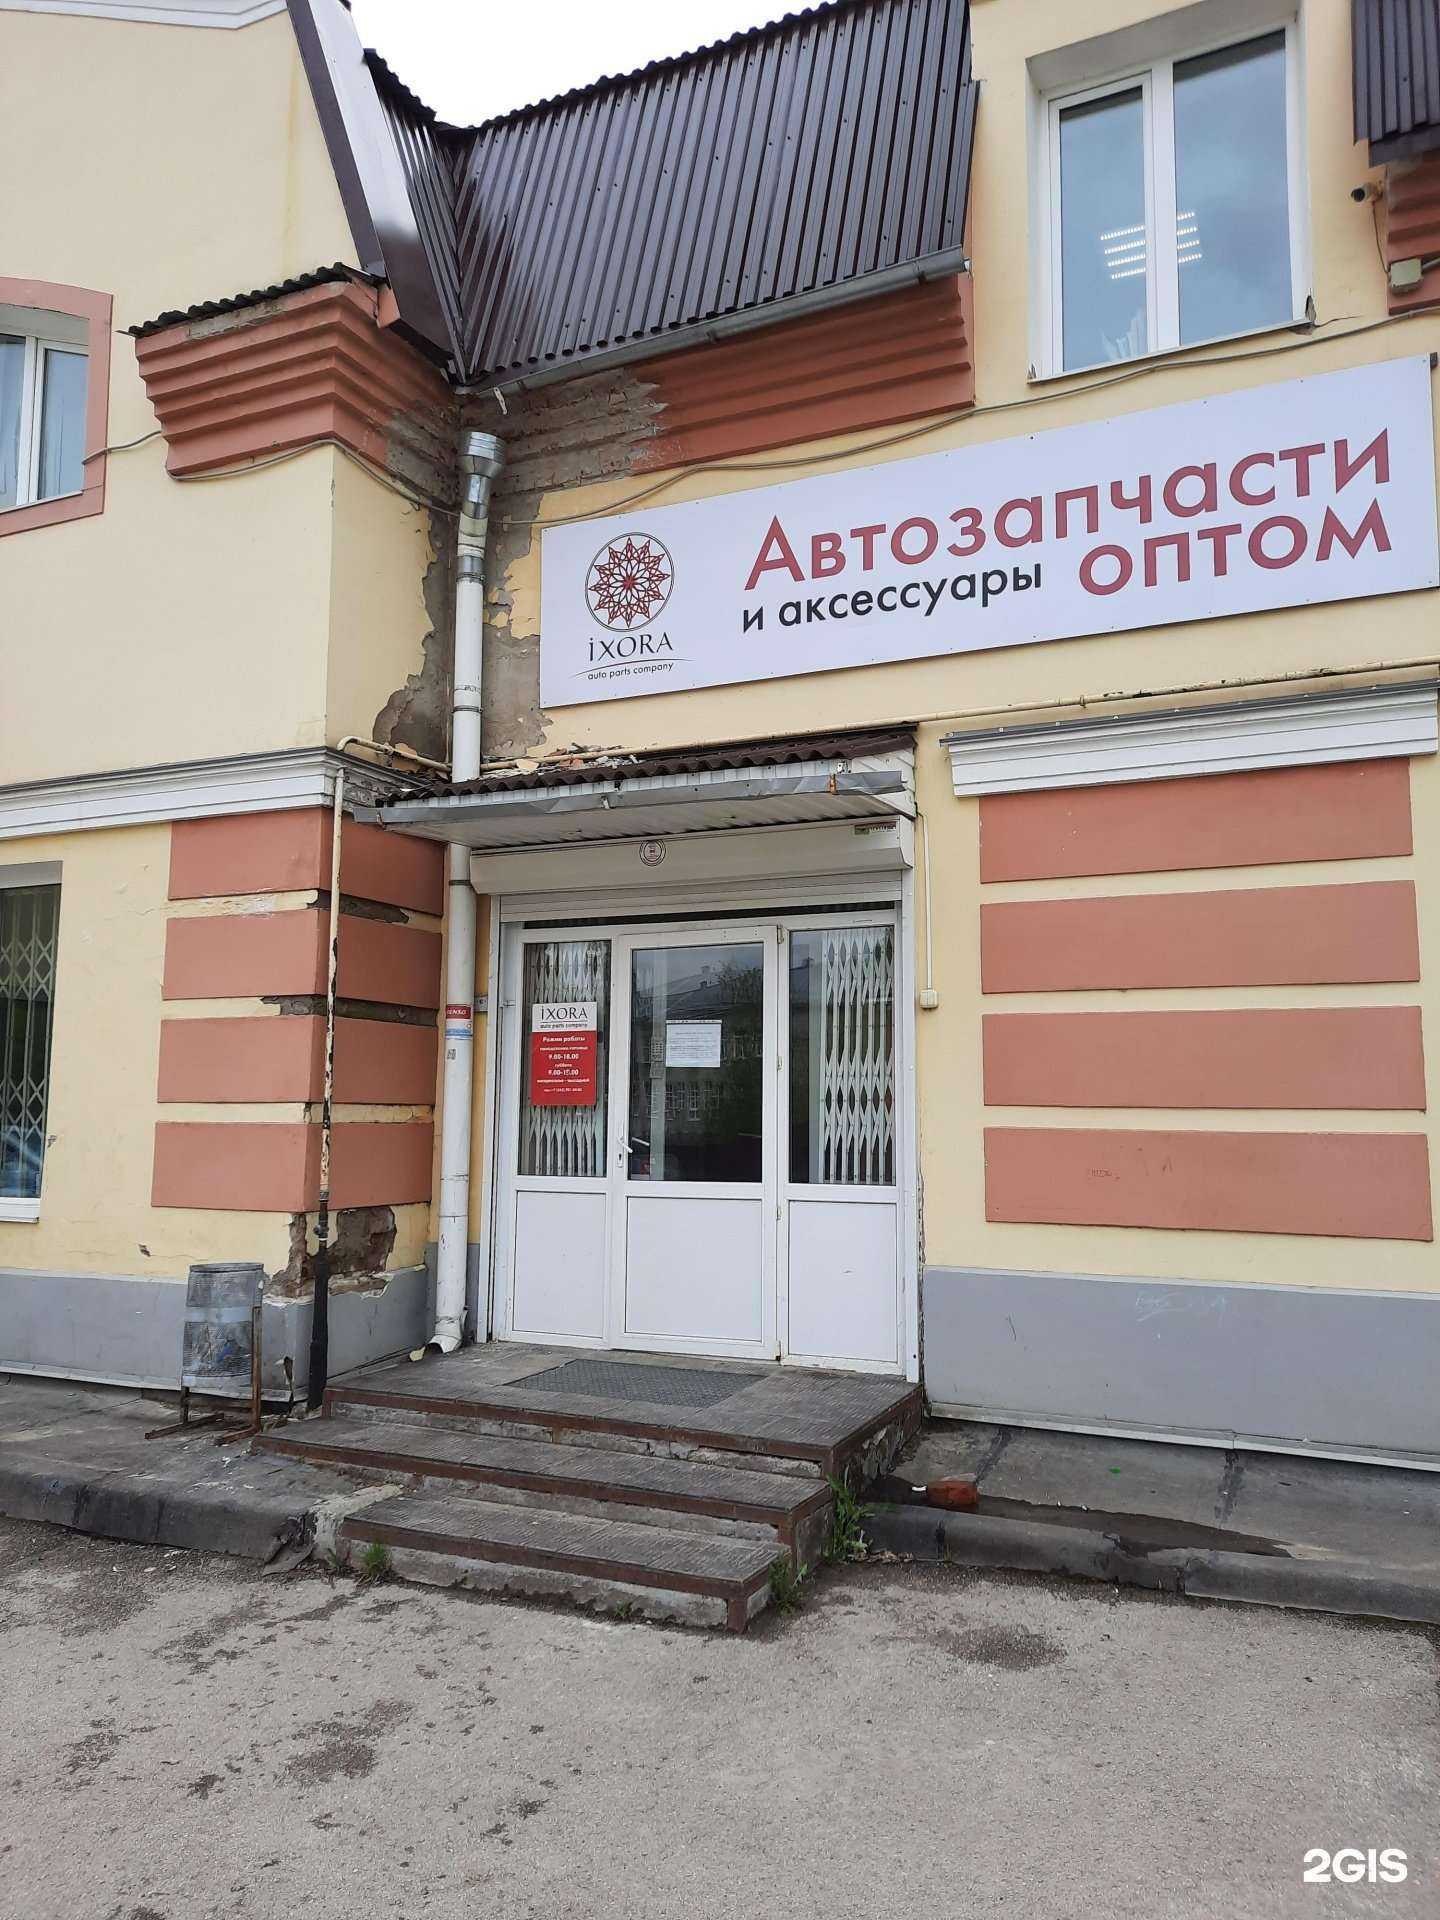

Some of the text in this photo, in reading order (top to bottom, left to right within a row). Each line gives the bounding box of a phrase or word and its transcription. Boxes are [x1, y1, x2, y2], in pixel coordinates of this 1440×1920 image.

[744, 427, 1391, 591] Автозапчасти
[1078, 497, 1392, 596] оптом
[742, 563, 1042, 633] и аксессуары
[588, 662, 674, 680] auto parts company
